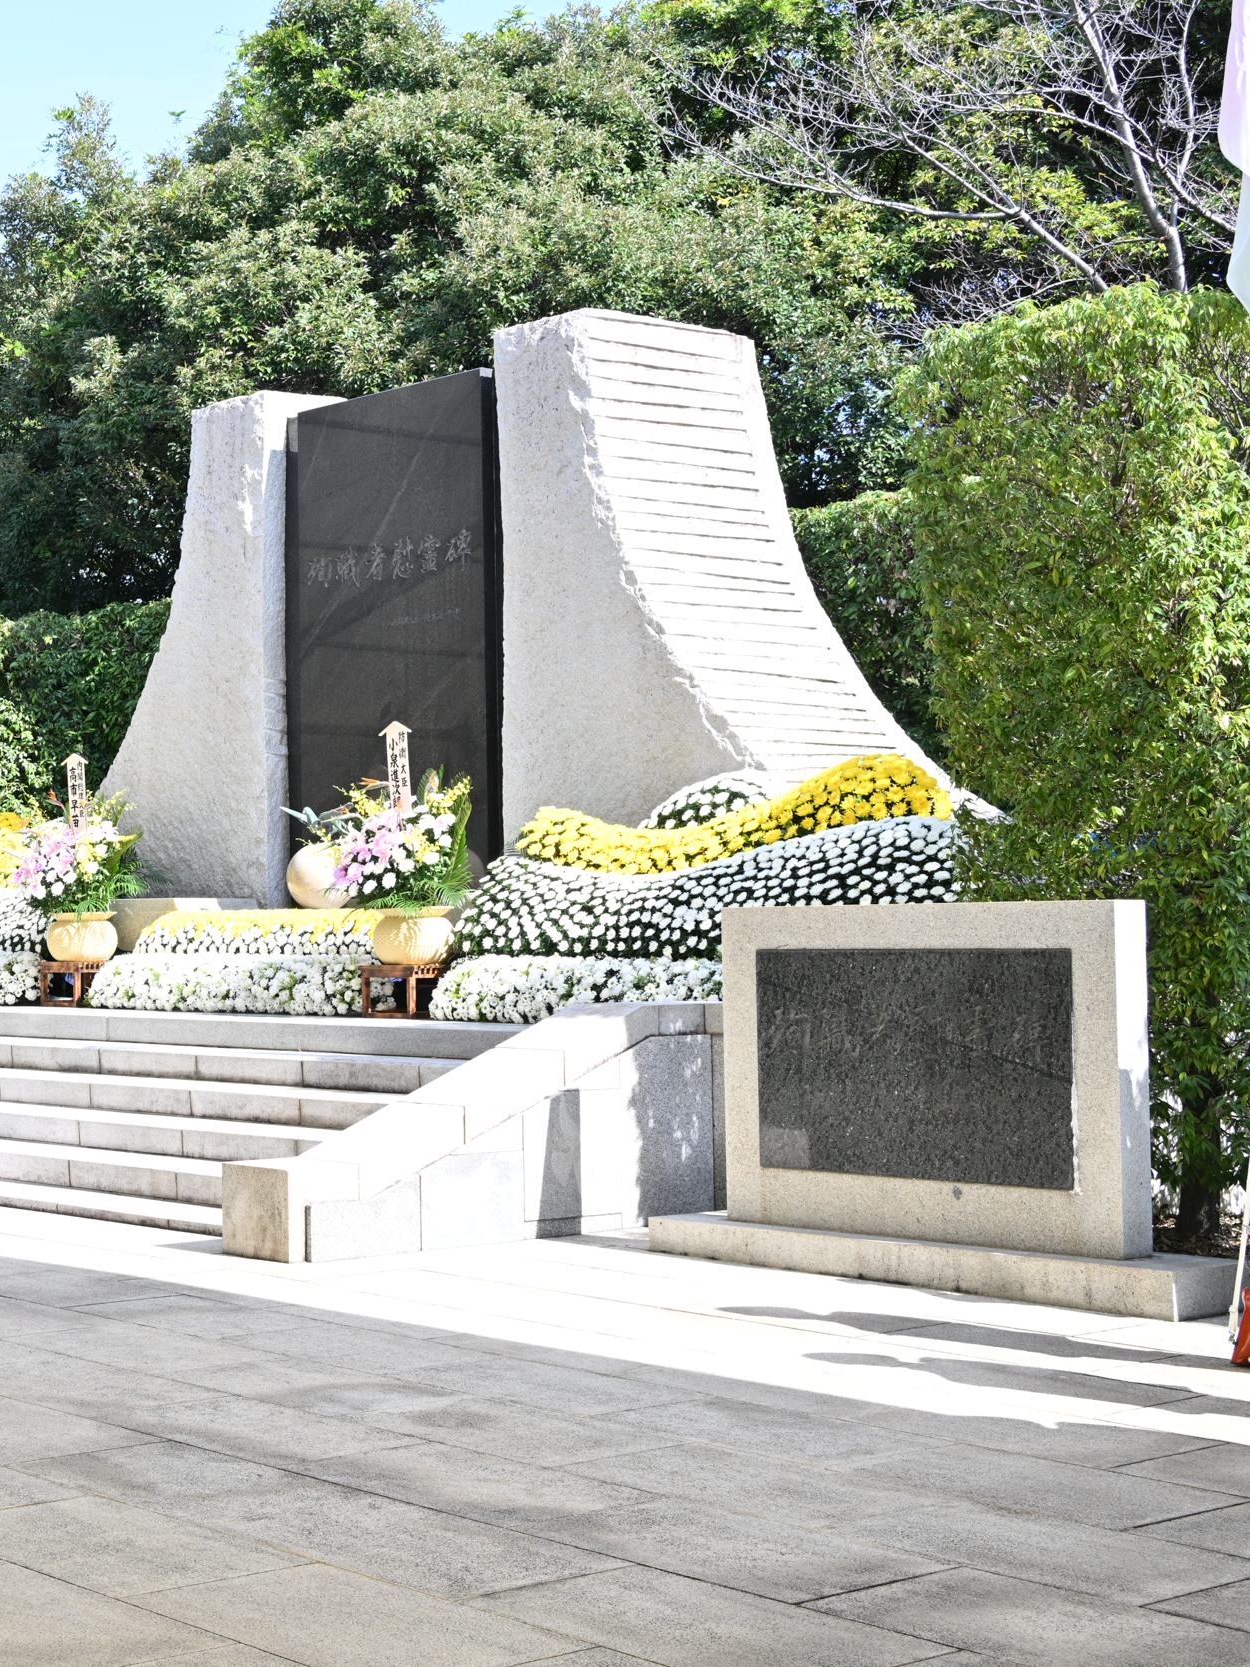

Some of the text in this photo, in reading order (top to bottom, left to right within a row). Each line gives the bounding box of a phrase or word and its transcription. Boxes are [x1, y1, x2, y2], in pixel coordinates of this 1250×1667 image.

[398, 731, 408, 787] 防衛大臣
[69, 766, 80, 828] 高市早苗
